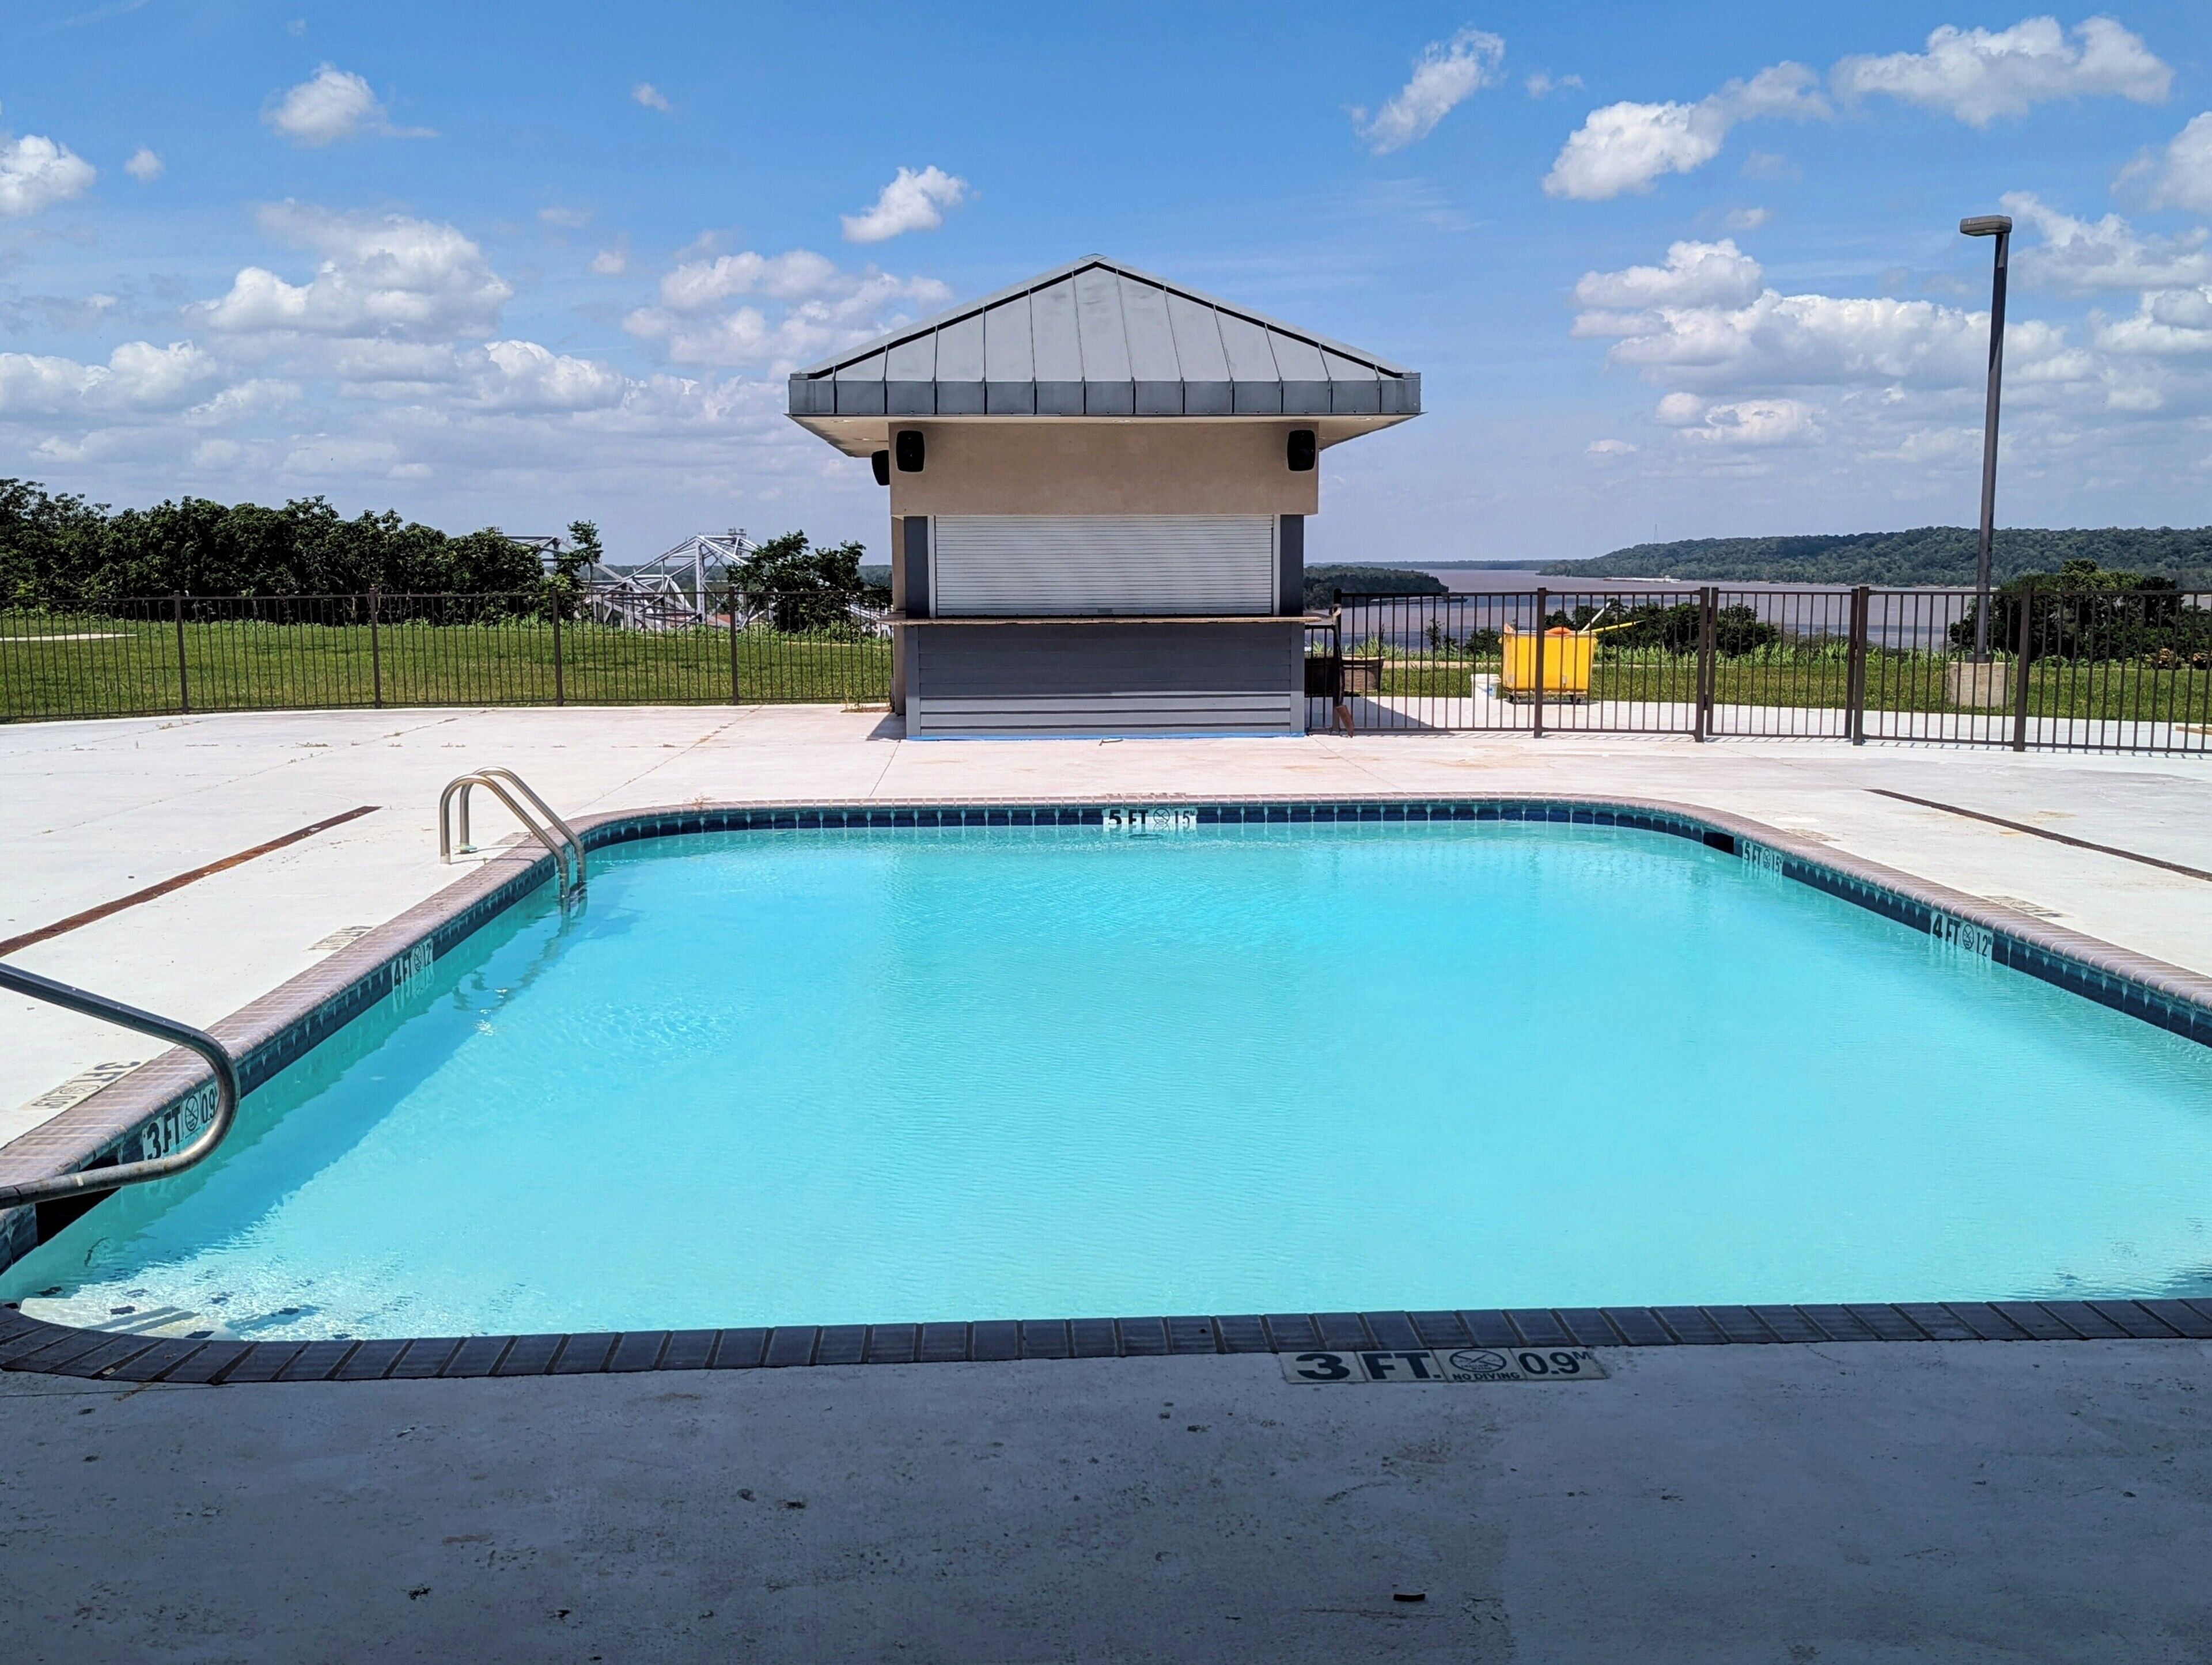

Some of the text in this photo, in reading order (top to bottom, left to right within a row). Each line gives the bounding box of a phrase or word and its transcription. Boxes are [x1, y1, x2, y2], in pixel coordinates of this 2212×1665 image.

[1109, 809, 1122, 825] 5
[1128, 809, 1149, 824] FT
[1933, 913, 1943, 939] 4
[394, 959, 402, 987] 4
[147, 1122, 161, 1160] 3
[1296, 1353, 1351, 1380] 3
[1360, 1352, 1441, 1379] FT.
[1474, 1372, 1521, 1380] DIVING
